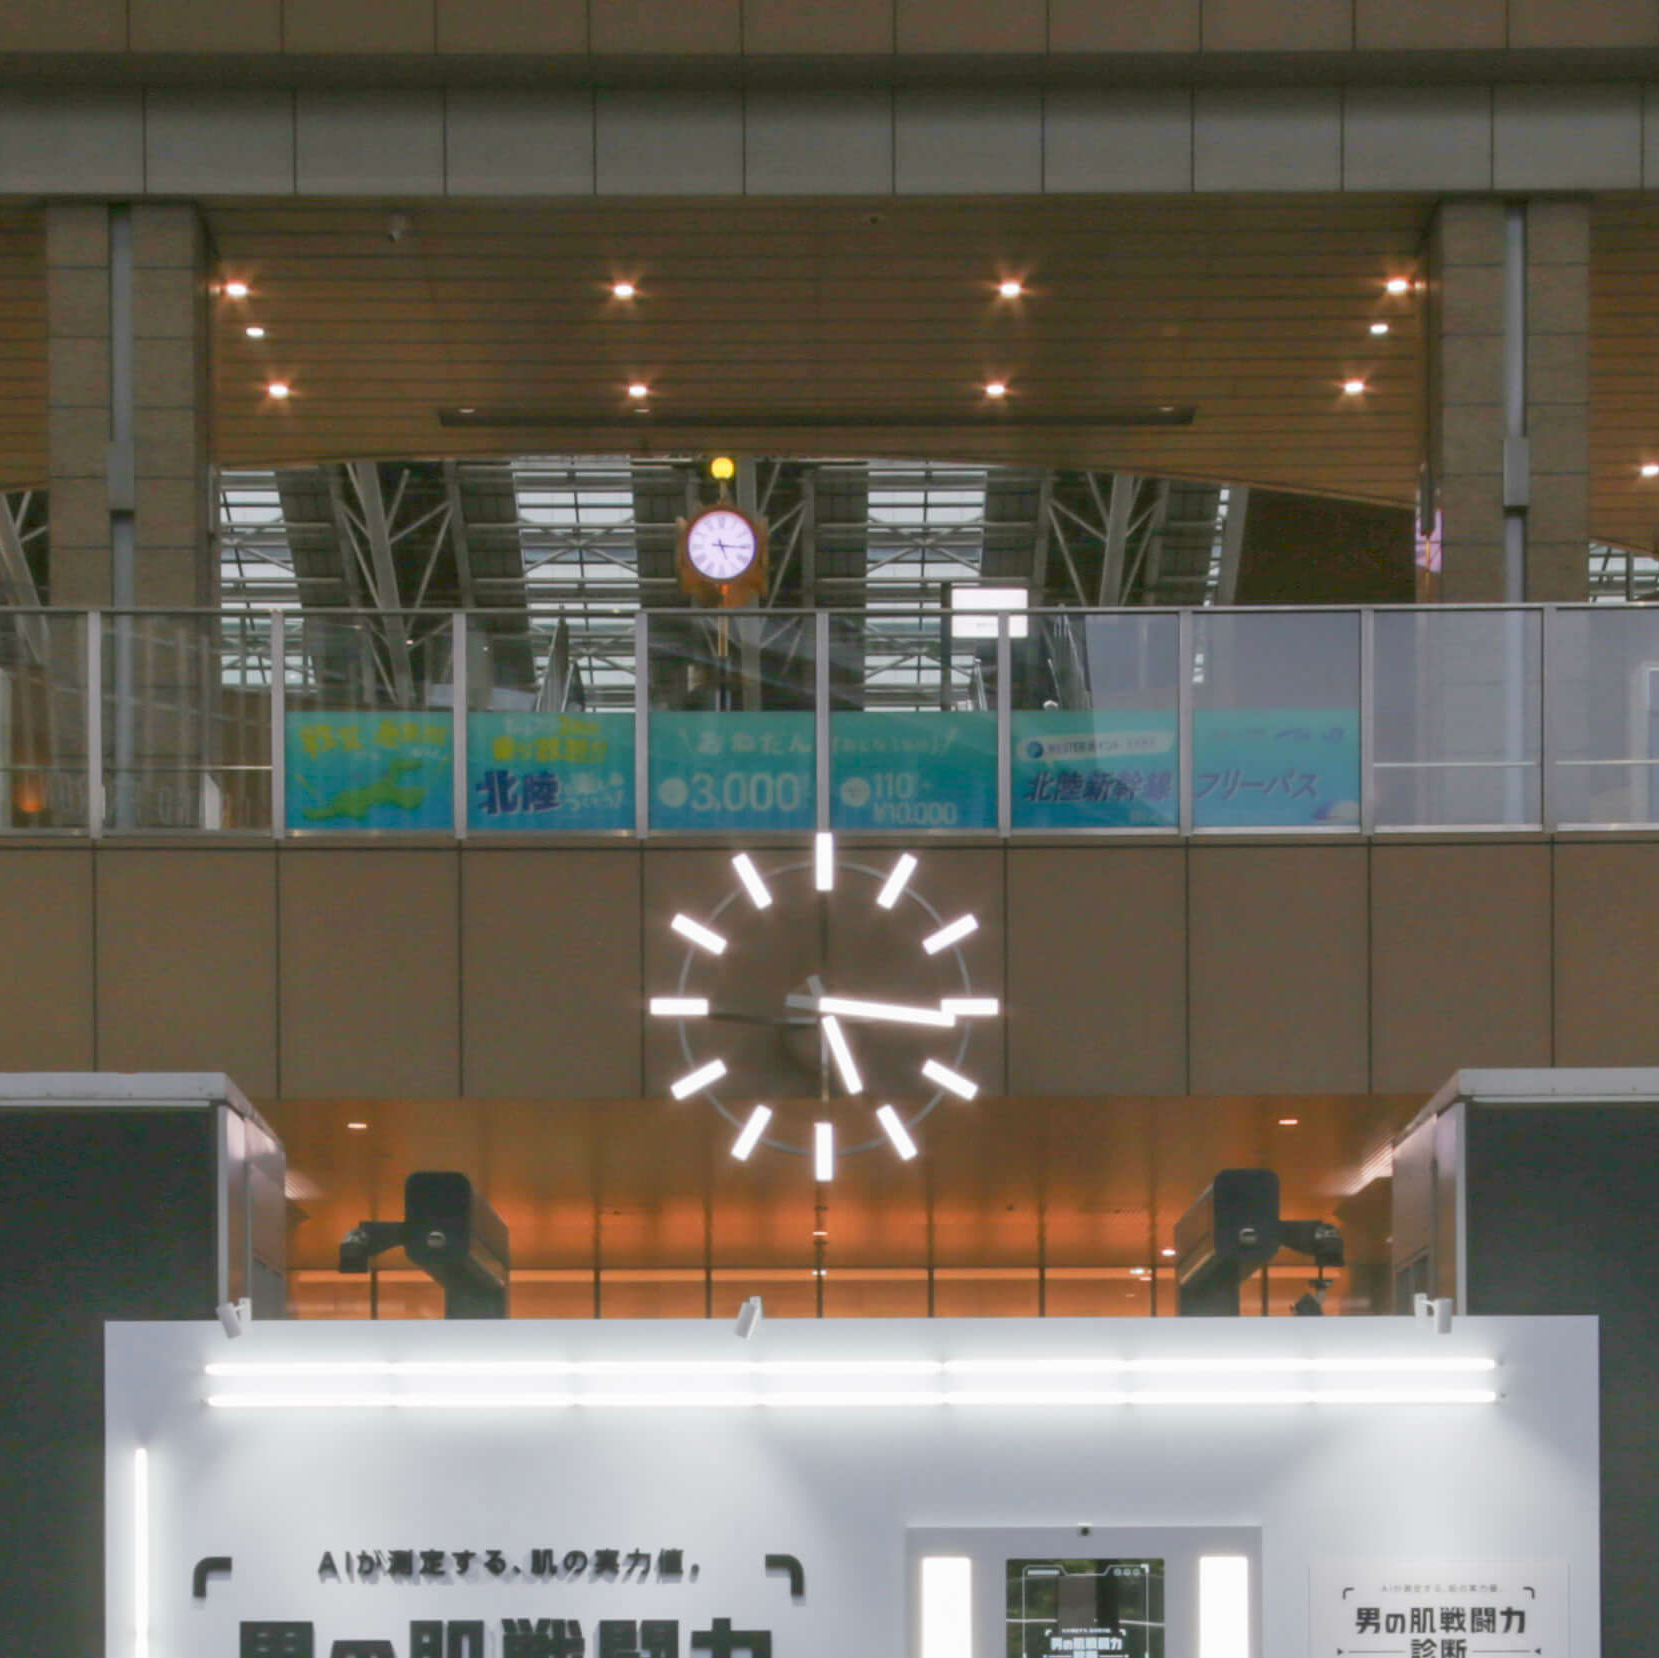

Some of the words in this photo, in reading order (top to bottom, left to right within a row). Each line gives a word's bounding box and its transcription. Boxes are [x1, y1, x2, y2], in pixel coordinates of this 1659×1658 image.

[1193, 768, 1320, 801] フリーパス
[1355, 1606, 1526, 1635] 男の肌戦闘力
